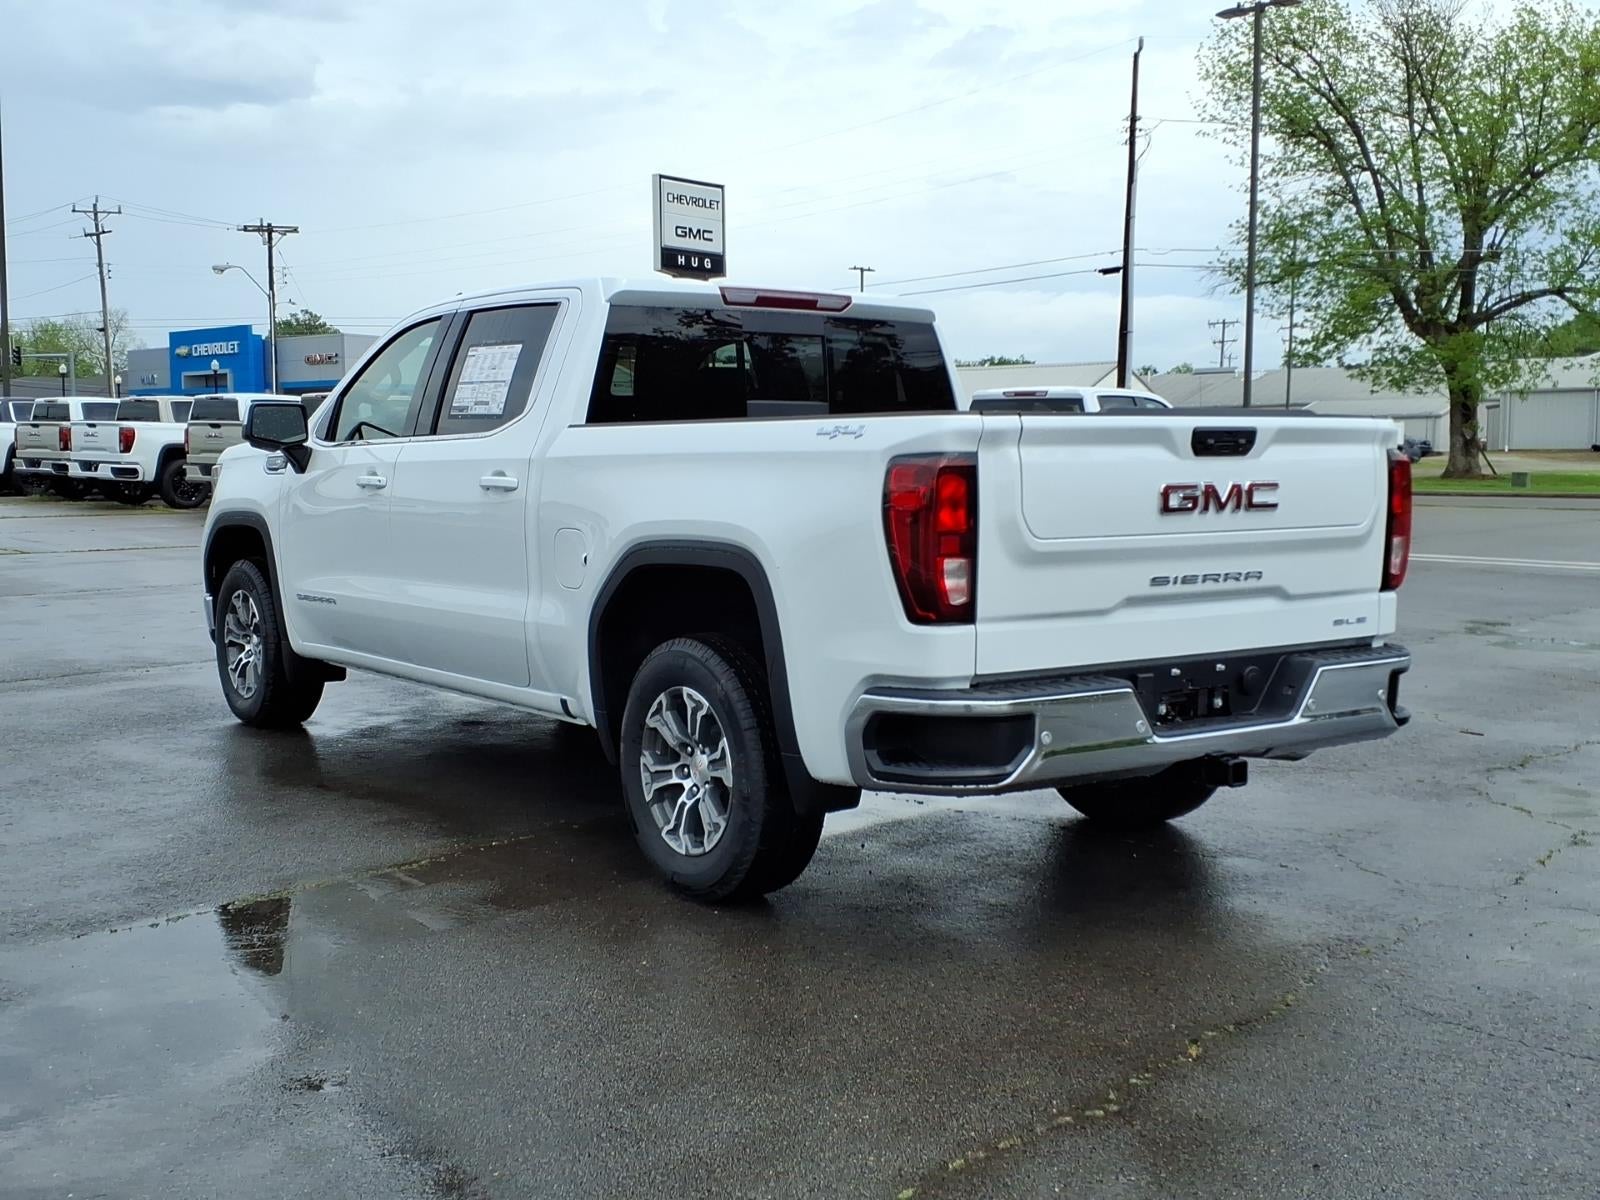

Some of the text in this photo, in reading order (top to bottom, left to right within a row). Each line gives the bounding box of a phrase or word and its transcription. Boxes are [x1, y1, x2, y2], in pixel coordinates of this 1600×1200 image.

[666, 192, 720, 210] CHEVROLET
[675, 225, 713, 242] GMC
[678, 255, 711, 268] HUG
[192, 340, 240, 356] CHEVROLET
[304, 353, 338, 365] GMC
[1159, 480, 1279, 516] GMC
[1149, 570, 1263, 587] SIERRA
[1332, 616, 1367, 626] SLE
